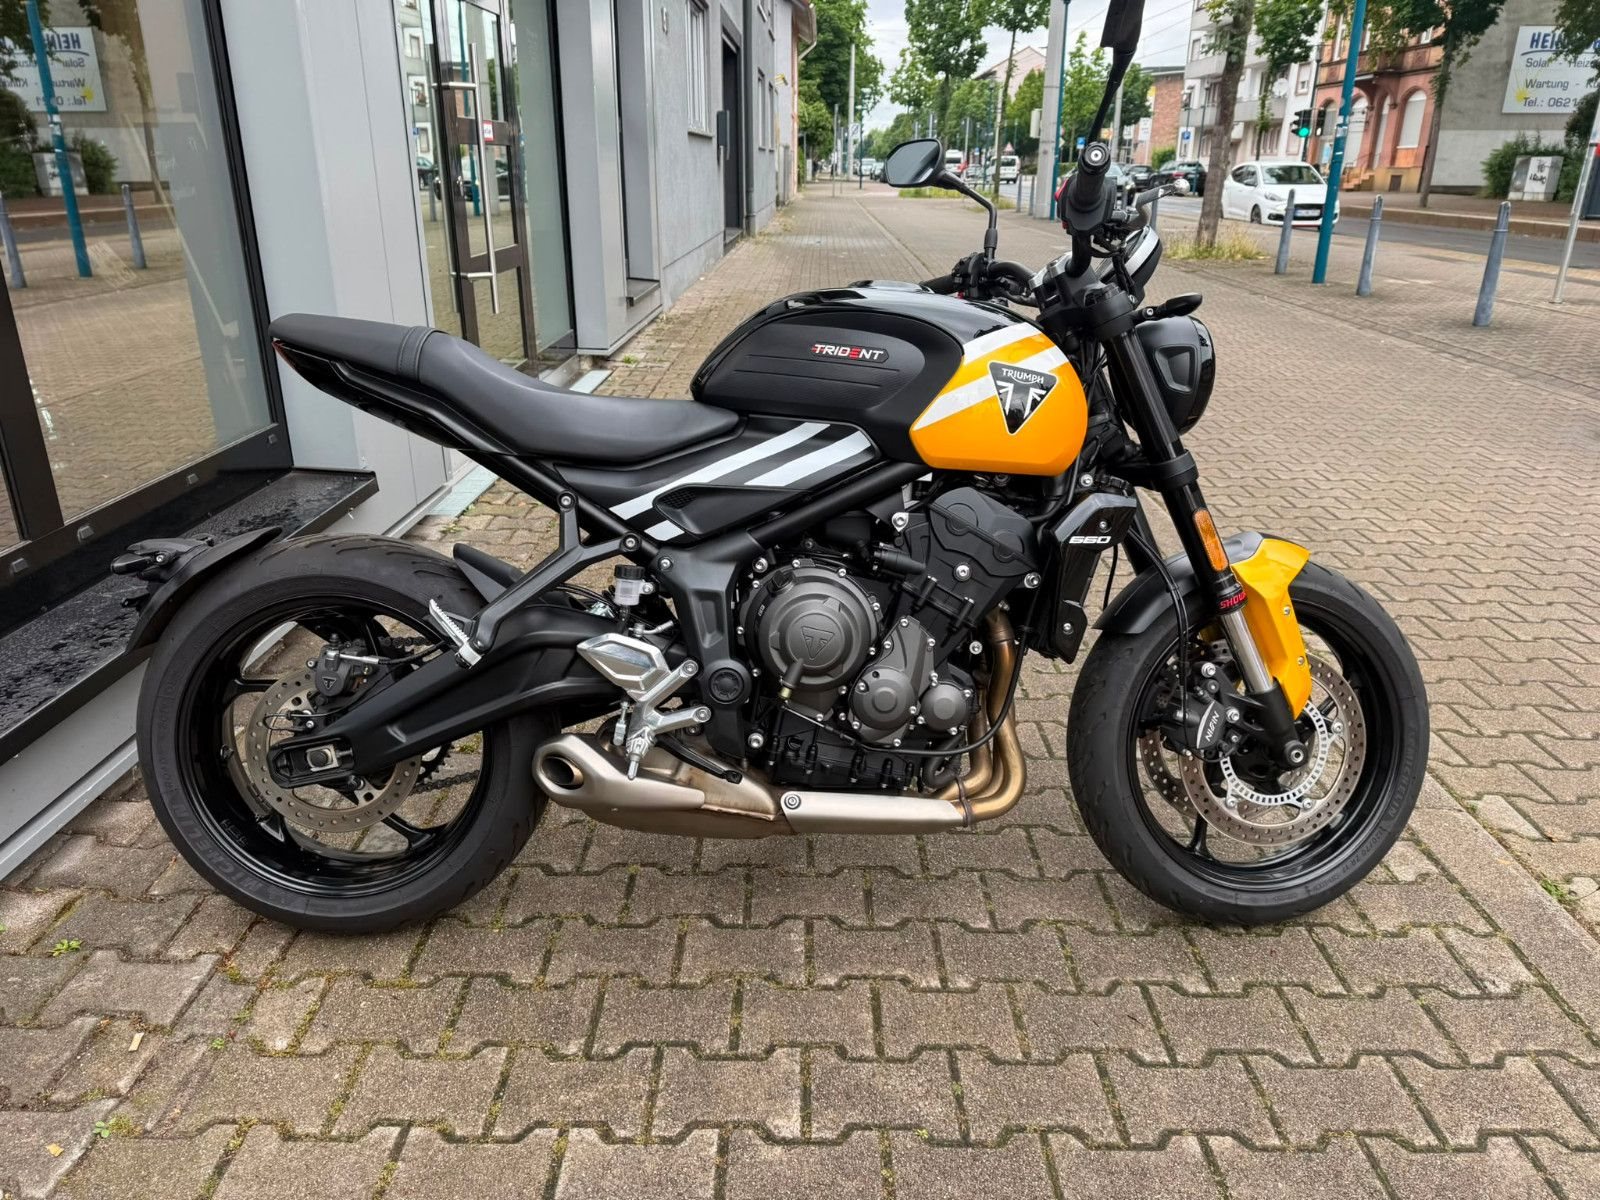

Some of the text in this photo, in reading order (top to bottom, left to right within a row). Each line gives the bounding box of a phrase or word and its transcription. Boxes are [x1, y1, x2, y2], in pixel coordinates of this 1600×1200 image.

[1525, 78, 1569, 91] Wartung
[1523, 97, 1543, 107] Tel.:
[811, 343, 884, 361] TRIDENT
[1001, 367, 1045, 385] TRIUMPH
[1068, 535, 1112, 544] 660
